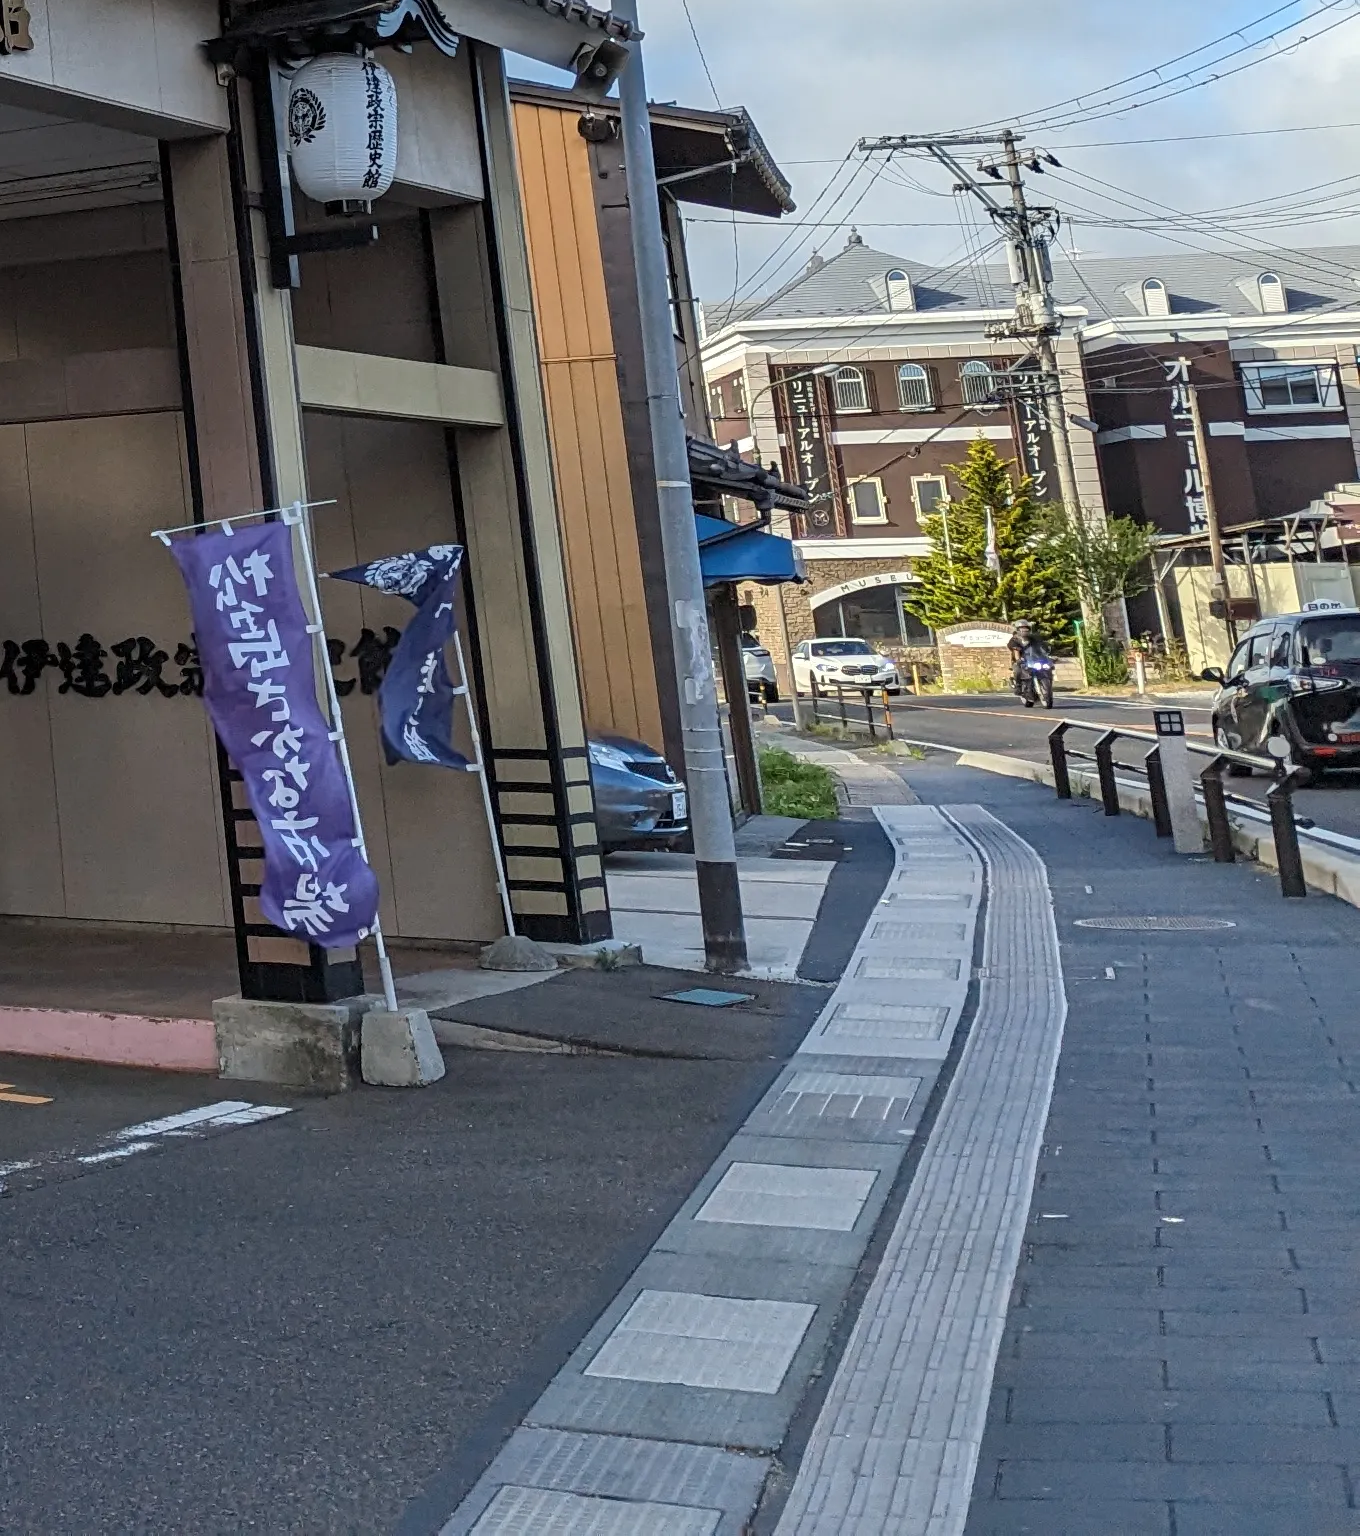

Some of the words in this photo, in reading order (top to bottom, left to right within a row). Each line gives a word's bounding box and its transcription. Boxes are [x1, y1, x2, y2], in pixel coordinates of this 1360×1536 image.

[791, 380, 820, 504] リニューアルオープン
